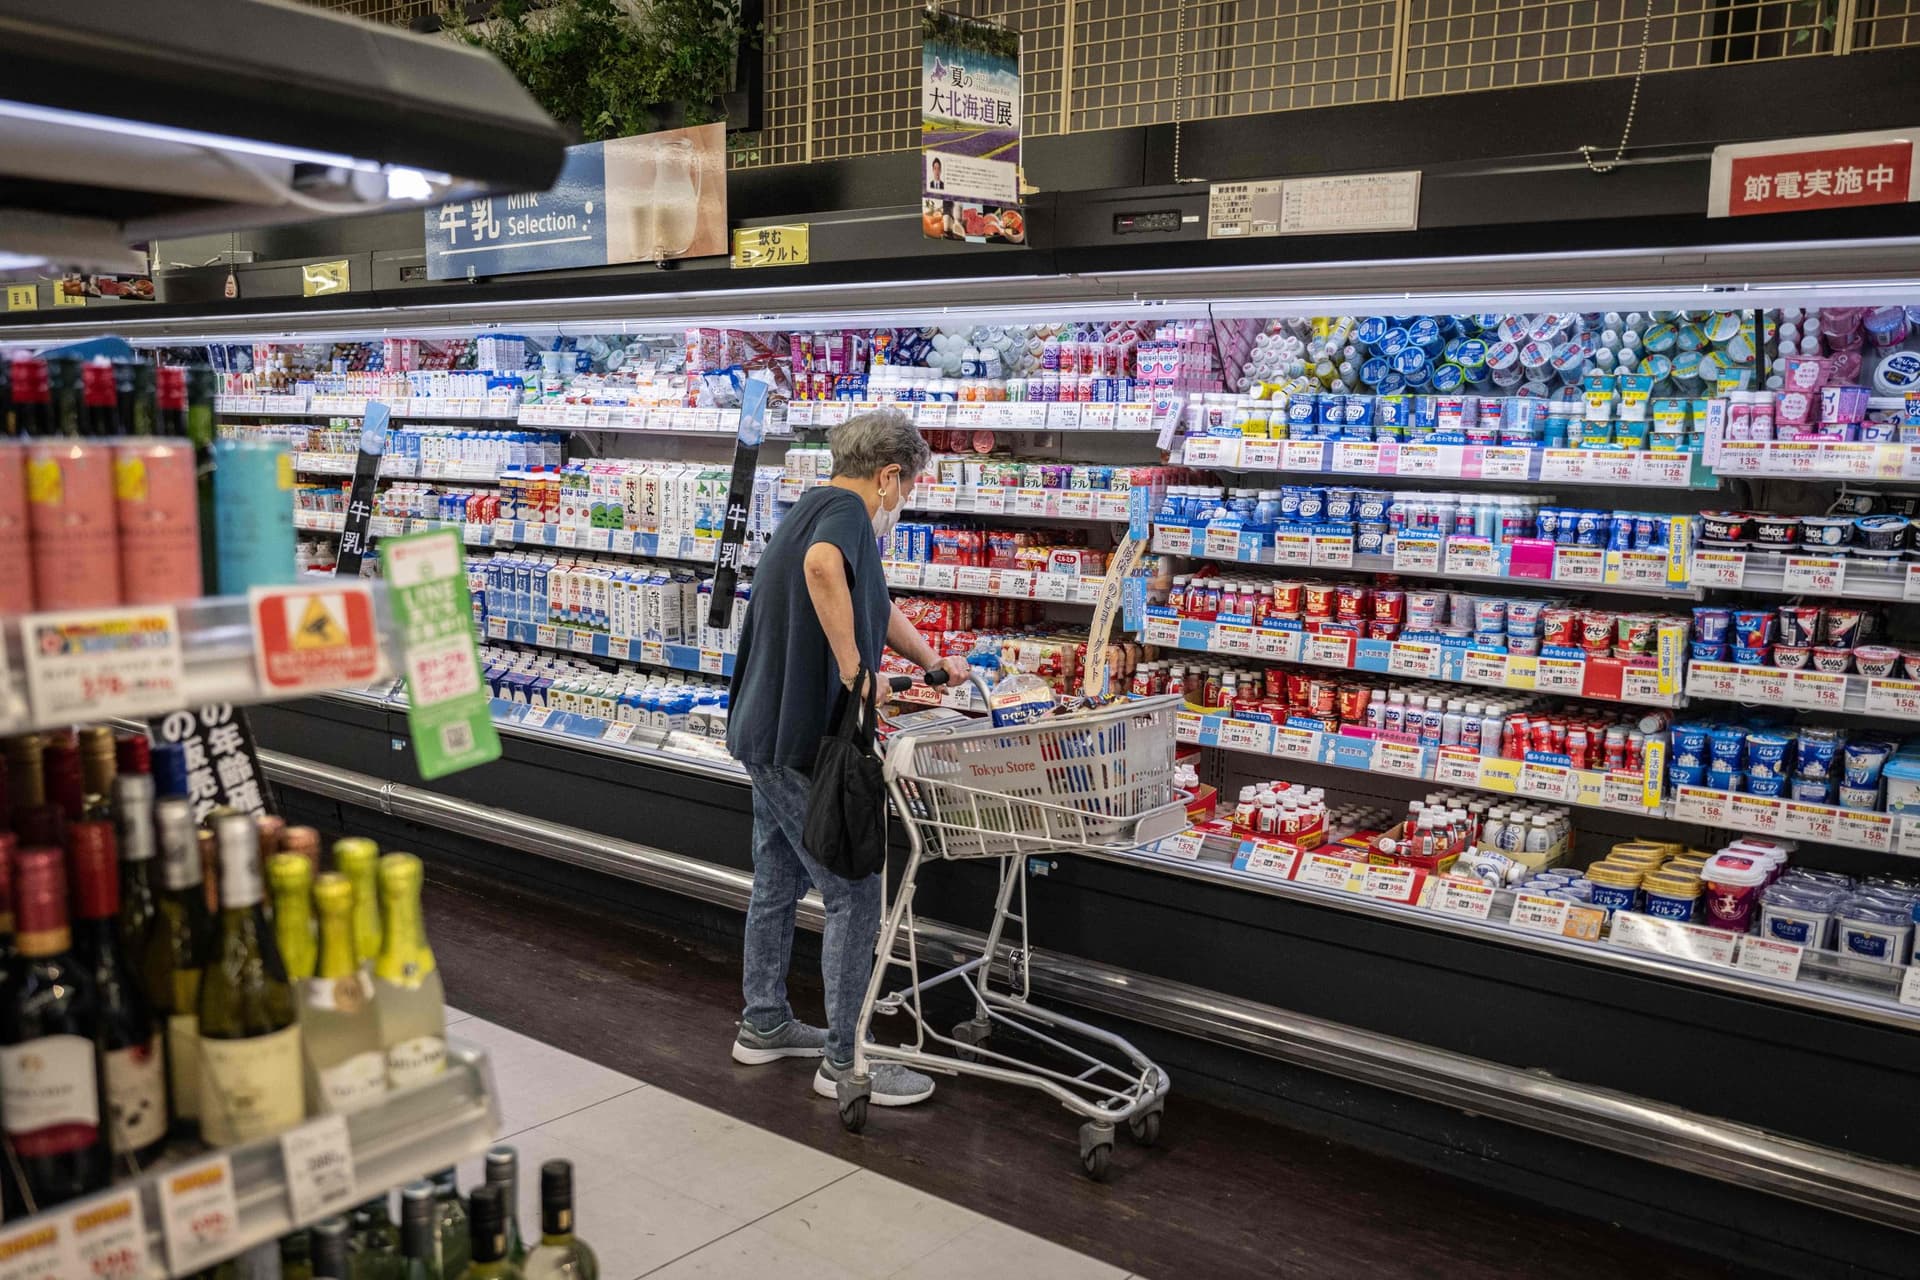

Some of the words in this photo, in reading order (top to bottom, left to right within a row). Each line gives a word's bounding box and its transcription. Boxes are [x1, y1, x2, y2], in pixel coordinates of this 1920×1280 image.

[950, 66, 973, 88] 夏の
[929, 87, 1013, 127] 大北海道展
[1743, 163, 1894, 202] 節電実施中
[508, 210, 576, 236] Selection
[758, 229, 782, 246] 飲む
[742, 246, 800, 263] ヨーグルト
[983, 476, 999, 487] ラブレ
[1024, 477, 1041, 488] ラブレ
[1071, 478, 1089, 490] ラブレ
[1113, 480, 1130, 492] ラブレ
[342, 500, 370, 556] 牛乳
[1759, 525, 1784, 536] oikos
[720, 503, 746, 569] 牛乳
[1542, 649, 1585, 659] 組み合わせ自由
[1714, 742, 1740, 752] パルテノ
[1527, 753, 1570, 765] 組み合わせ自由
[969, 762, 1005, 778] Tokyu
[1006, 760, 1036, 773] Store
[1594, 894, 1629, 907] パルテノ
[1650, 903, 1687, 918] パルテノ
